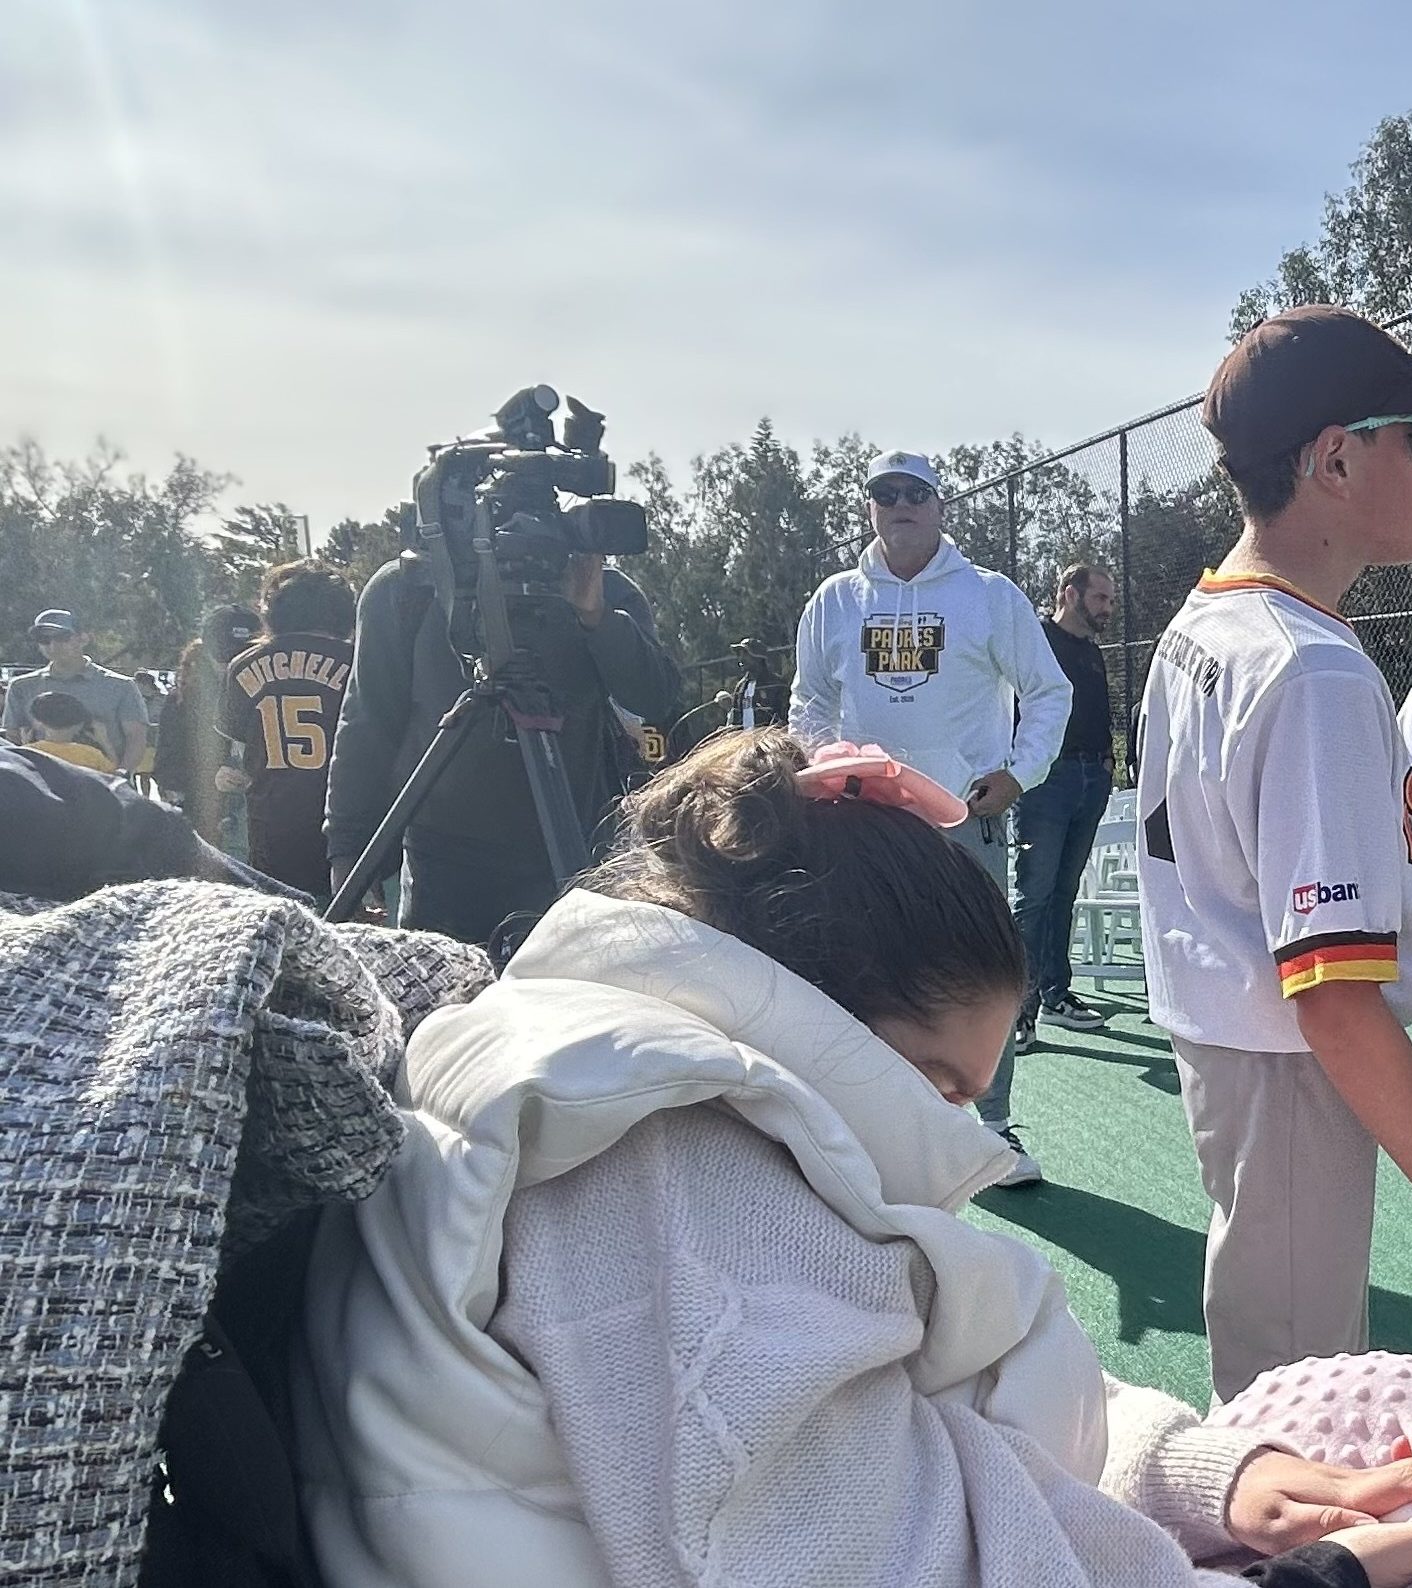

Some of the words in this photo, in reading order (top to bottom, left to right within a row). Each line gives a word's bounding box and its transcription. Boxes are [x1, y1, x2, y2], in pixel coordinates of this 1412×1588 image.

[236, 651, 351, 698] MITCHELL
[256, 695, 326, 769] 15
[1293, 881, 1360, 911] usban
